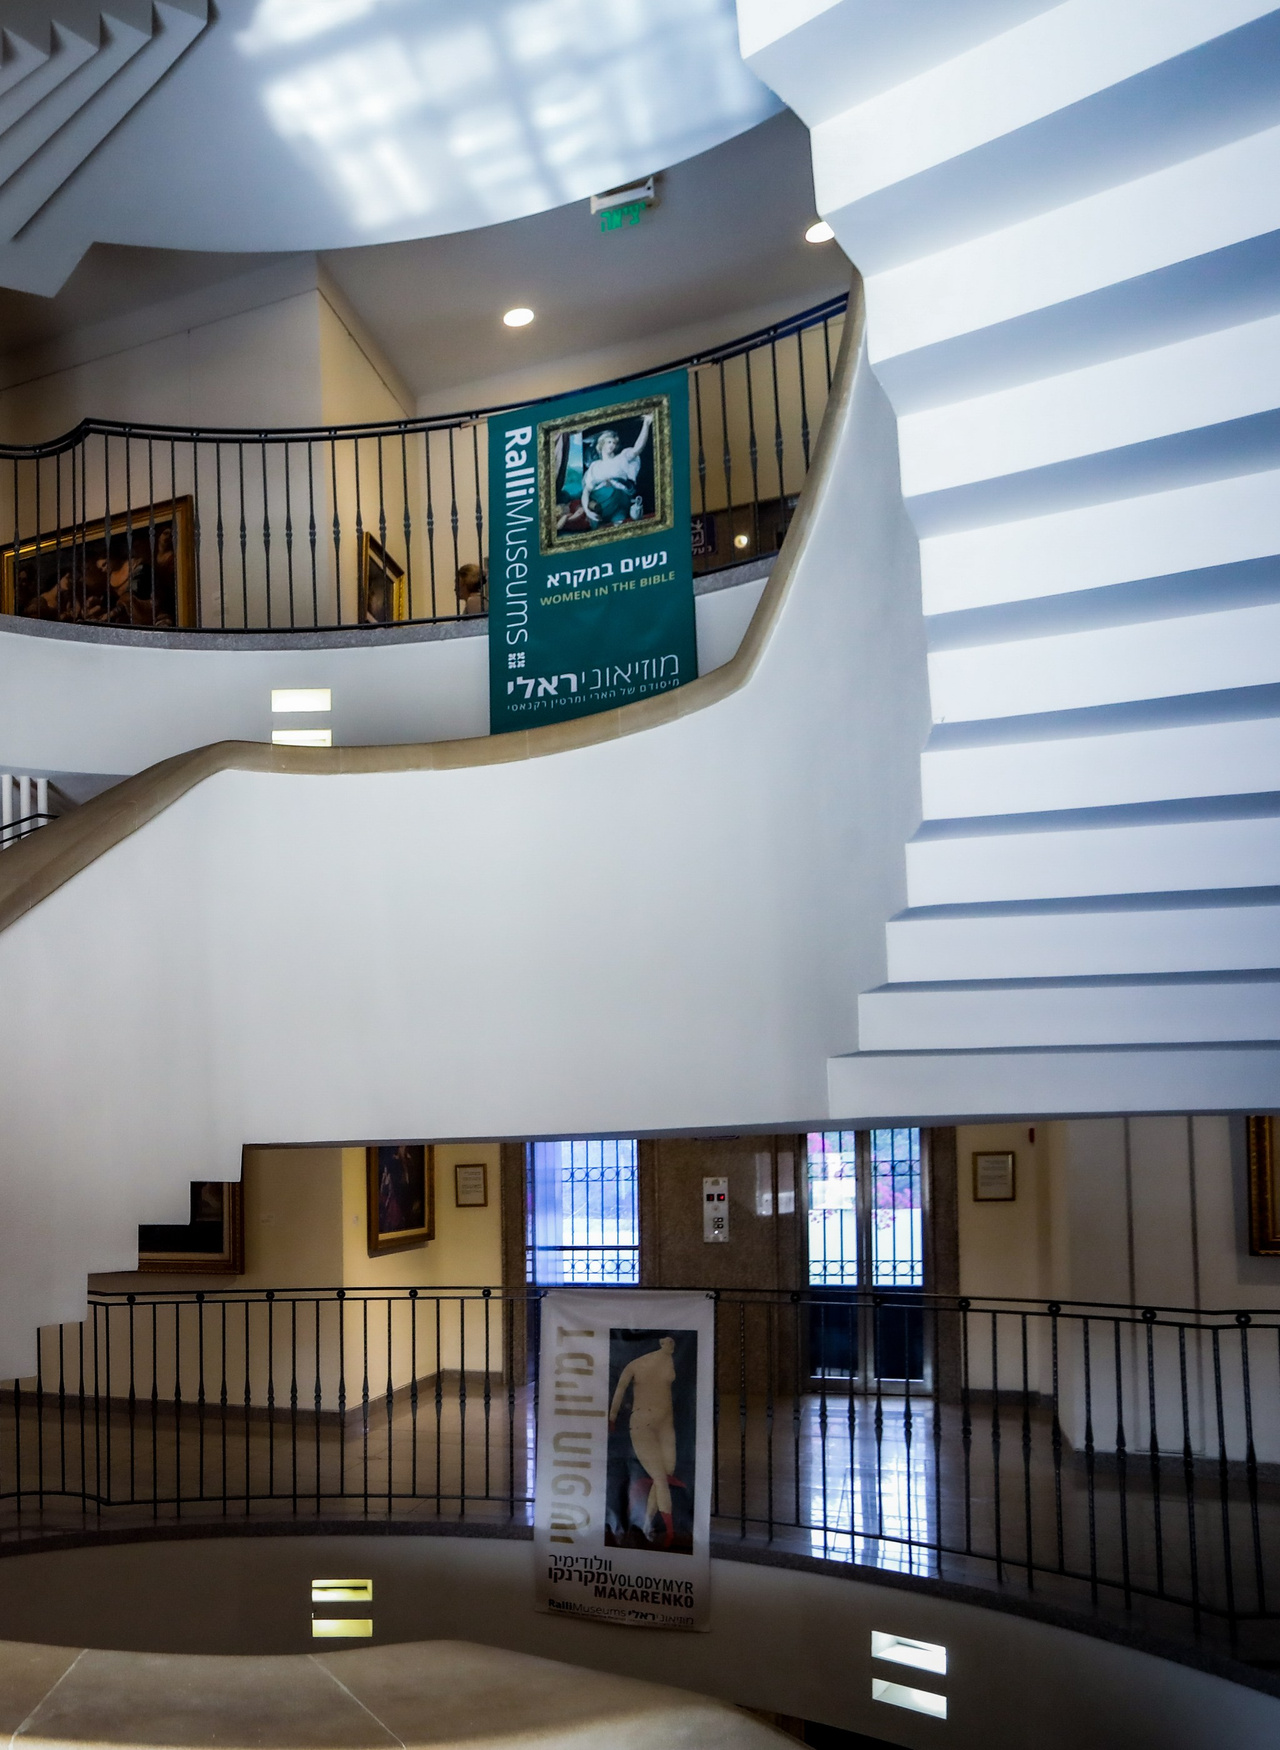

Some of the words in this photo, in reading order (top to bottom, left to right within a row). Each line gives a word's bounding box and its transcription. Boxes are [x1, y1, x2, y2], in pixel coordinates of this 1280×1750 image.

[620, 550, 668, 574] נשים
[547, 562, 614, 588] במקרא
[540, 590, 591, 606] WOMEN
[595, 585, 609, 597] IN
[612, 580, 636, 592] THE
[640, 570, 676, 588] BIBLE
[620, 685, 635, 696] של
[554, 1325, 606, 1418] דמיון
[549, 1430, 593, 1545] חופשי
[549, 1554, 612, 1572] וולודימיר
[548, 1567, 608, 1587] מקרנקו
[609, 1573, 694, 1595] VOLODYMYR
[594, 1585, 695, 1609] MAKARENKO
